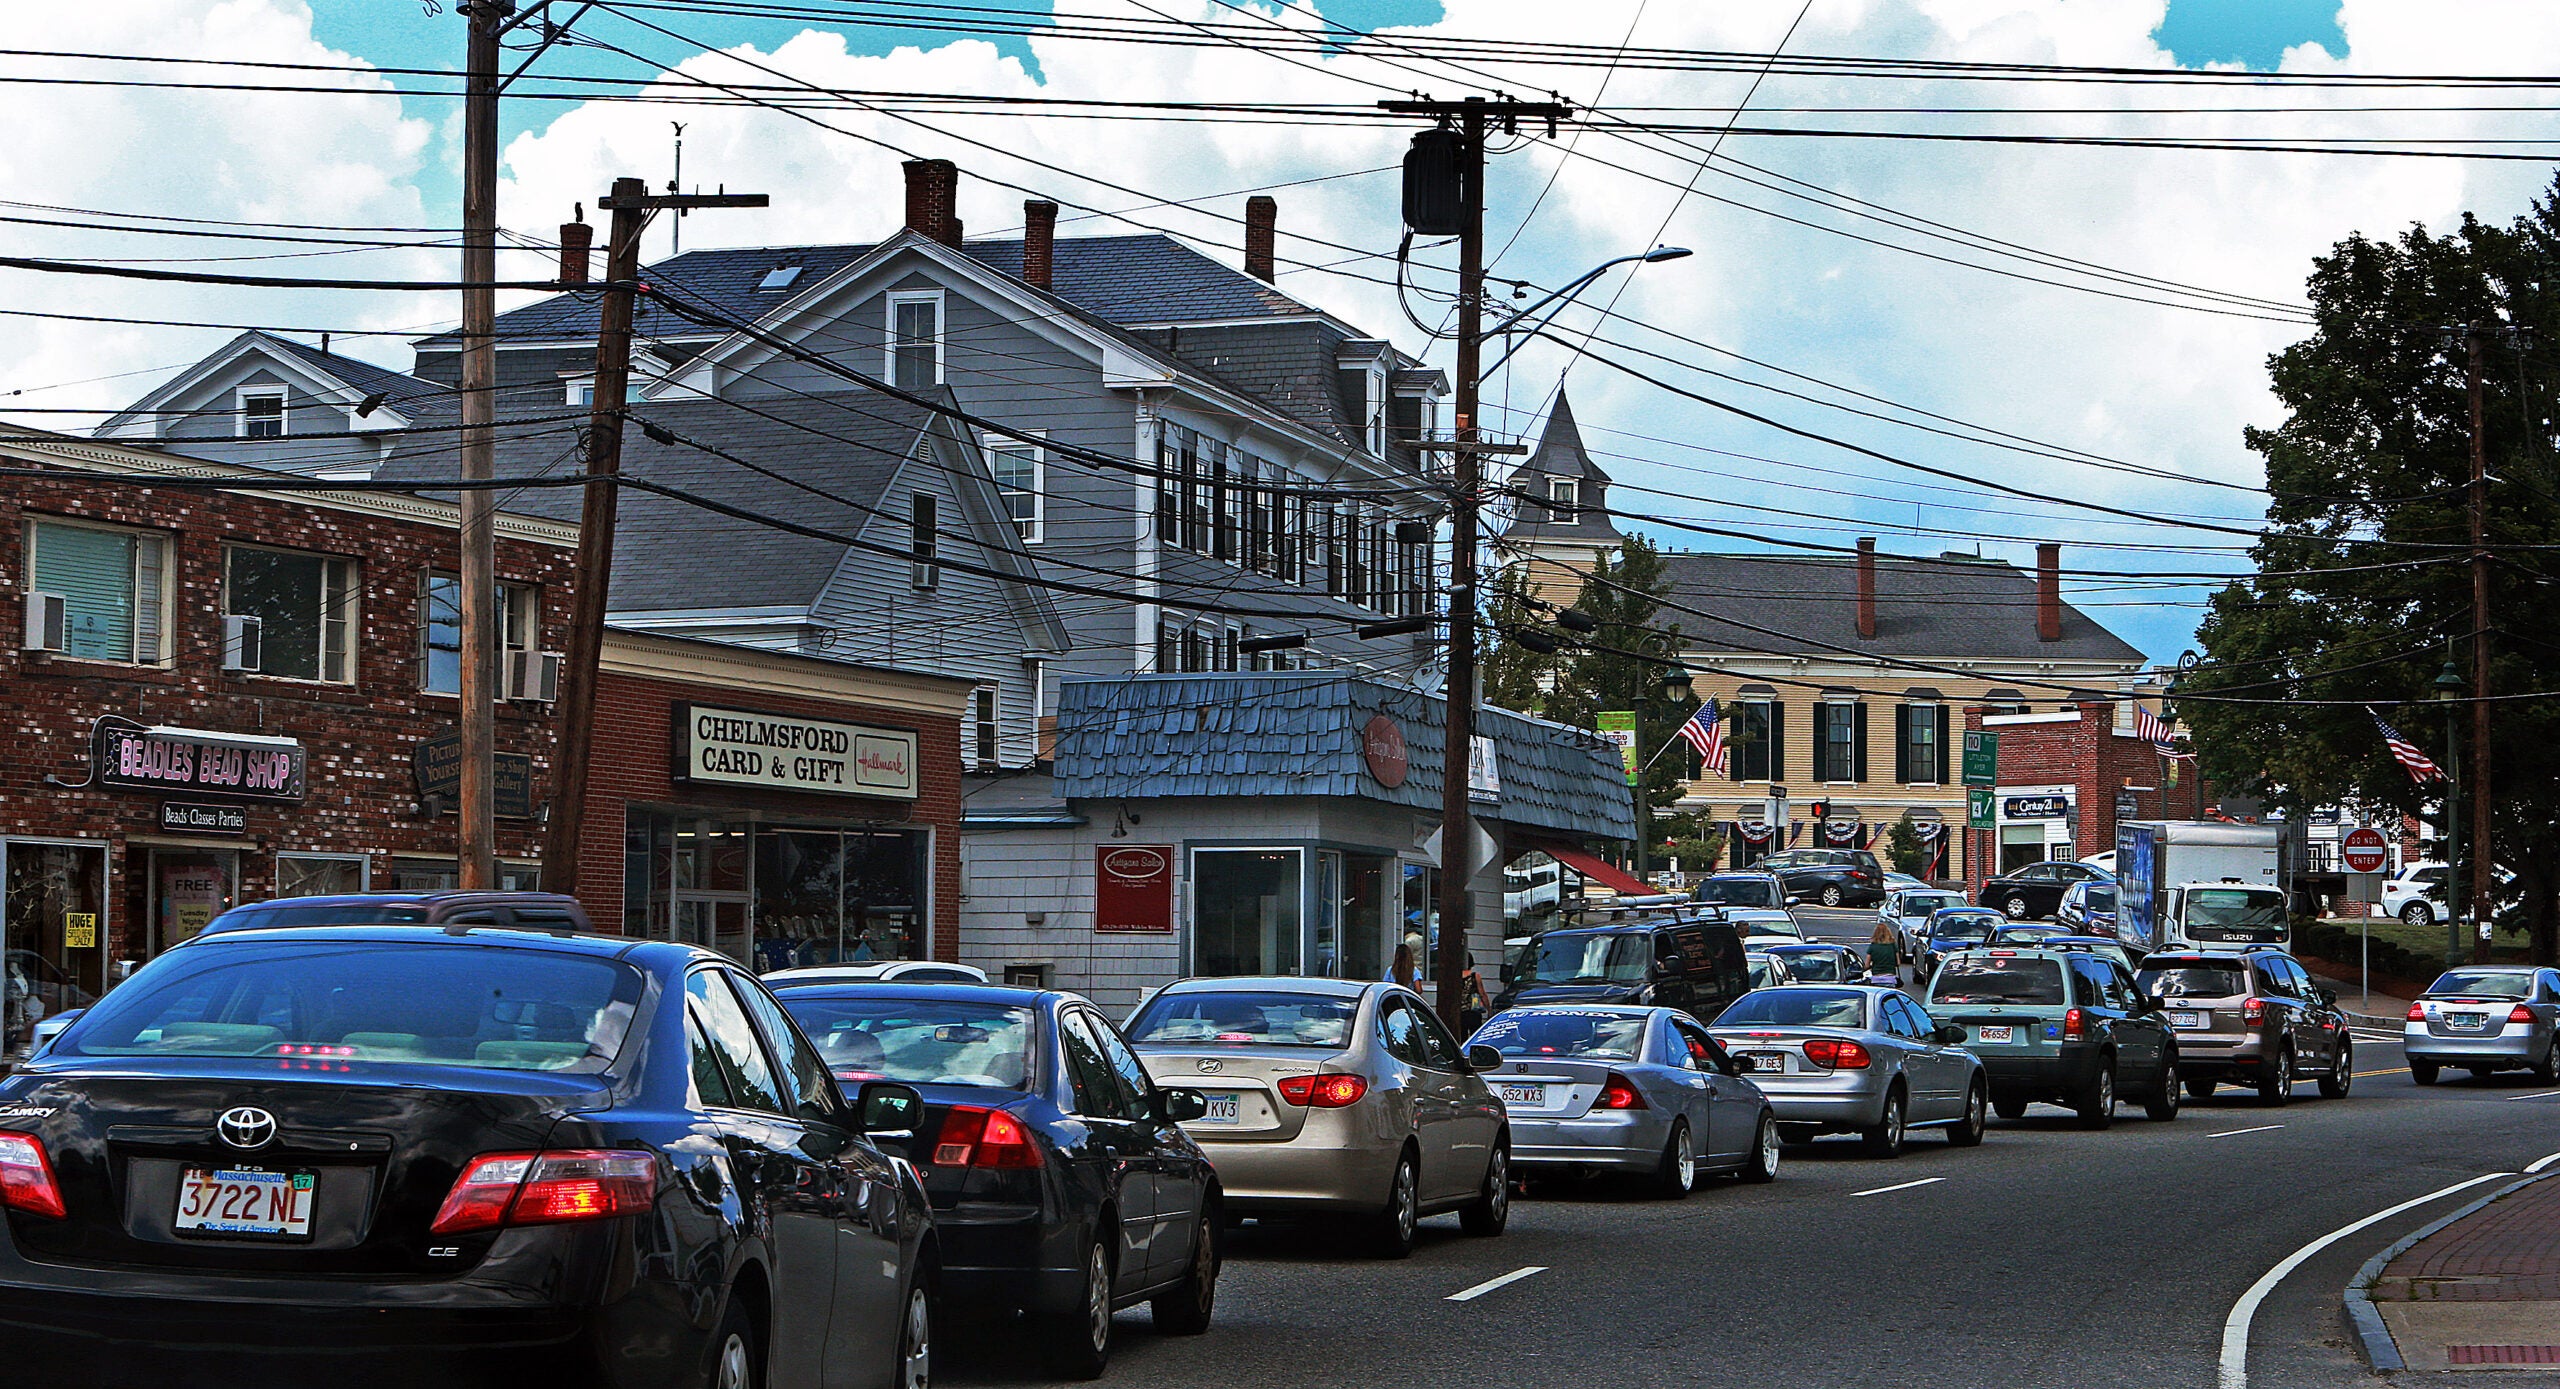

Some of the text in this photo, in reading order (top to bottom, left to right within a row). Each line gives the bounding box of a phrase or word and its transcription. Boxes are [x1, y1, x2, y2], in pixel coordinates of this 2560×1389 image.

[697, 714, 906, 777] CHELMSFORD Hallmark
[1968, 736, 1979, 749] 110
[429, 743, 460, 763] PICTUR
[119, 738, 290, 790] BEADLES BEAD SHOP
[507, 760, 527, 779] Shop
[702, 747, 844, 784] CARD & GIFT
[425, 763, 460, 783] YOURSE
[494, 775, 522, 794] Gallery
[1974, 805, 1979, 815] 4
[2019, 798, 2053, 812] Century 21
[165, 807, 244, 827] Beads Classes Parties
[2353, 857, 2376, 865] ENTER
[175, 879, 213, 891] FREE
[70, 914, 92, 928] HUGE
[182, 918, 205, 926] Nights
[1531, 1010, 1622, 1019] HONDA
[1502, 1089, 1543, 1101] 652 WX3
[0, 1107, 58, 1118] CAMRY
[1211, 1101, 1236, 1117] KV3
[213, 1169, 286, 1184] Massachusetts
[295, 1178, 309, 1188] 17
[183, 1182, 305, 1223] 3722 NL
[428, 1247, 459, 1257] CE
